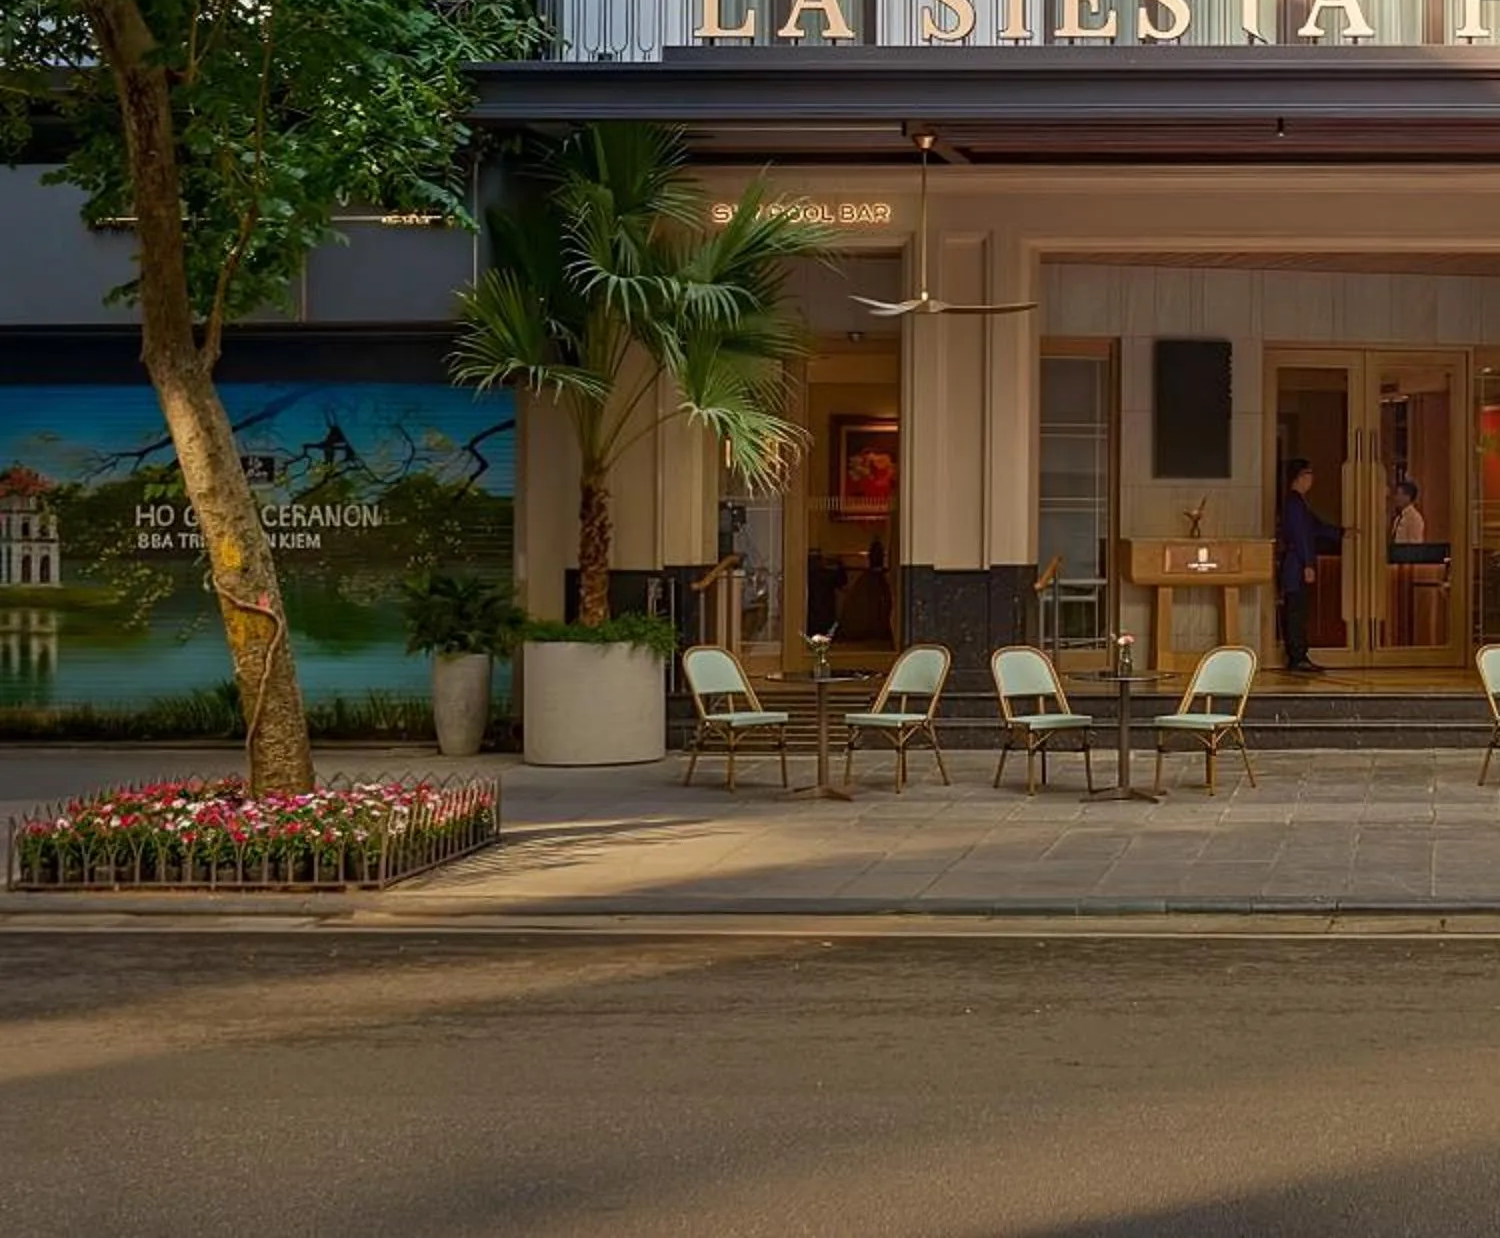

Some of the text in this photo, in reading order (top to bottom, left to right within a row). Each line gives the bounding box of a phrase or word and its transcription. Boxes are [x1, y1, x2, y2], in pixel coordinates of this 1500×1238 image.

[839, 203, 892, 224] BAR
[135, 504, 175, 528] HO
[279, 532, 321, 549] KIEM
